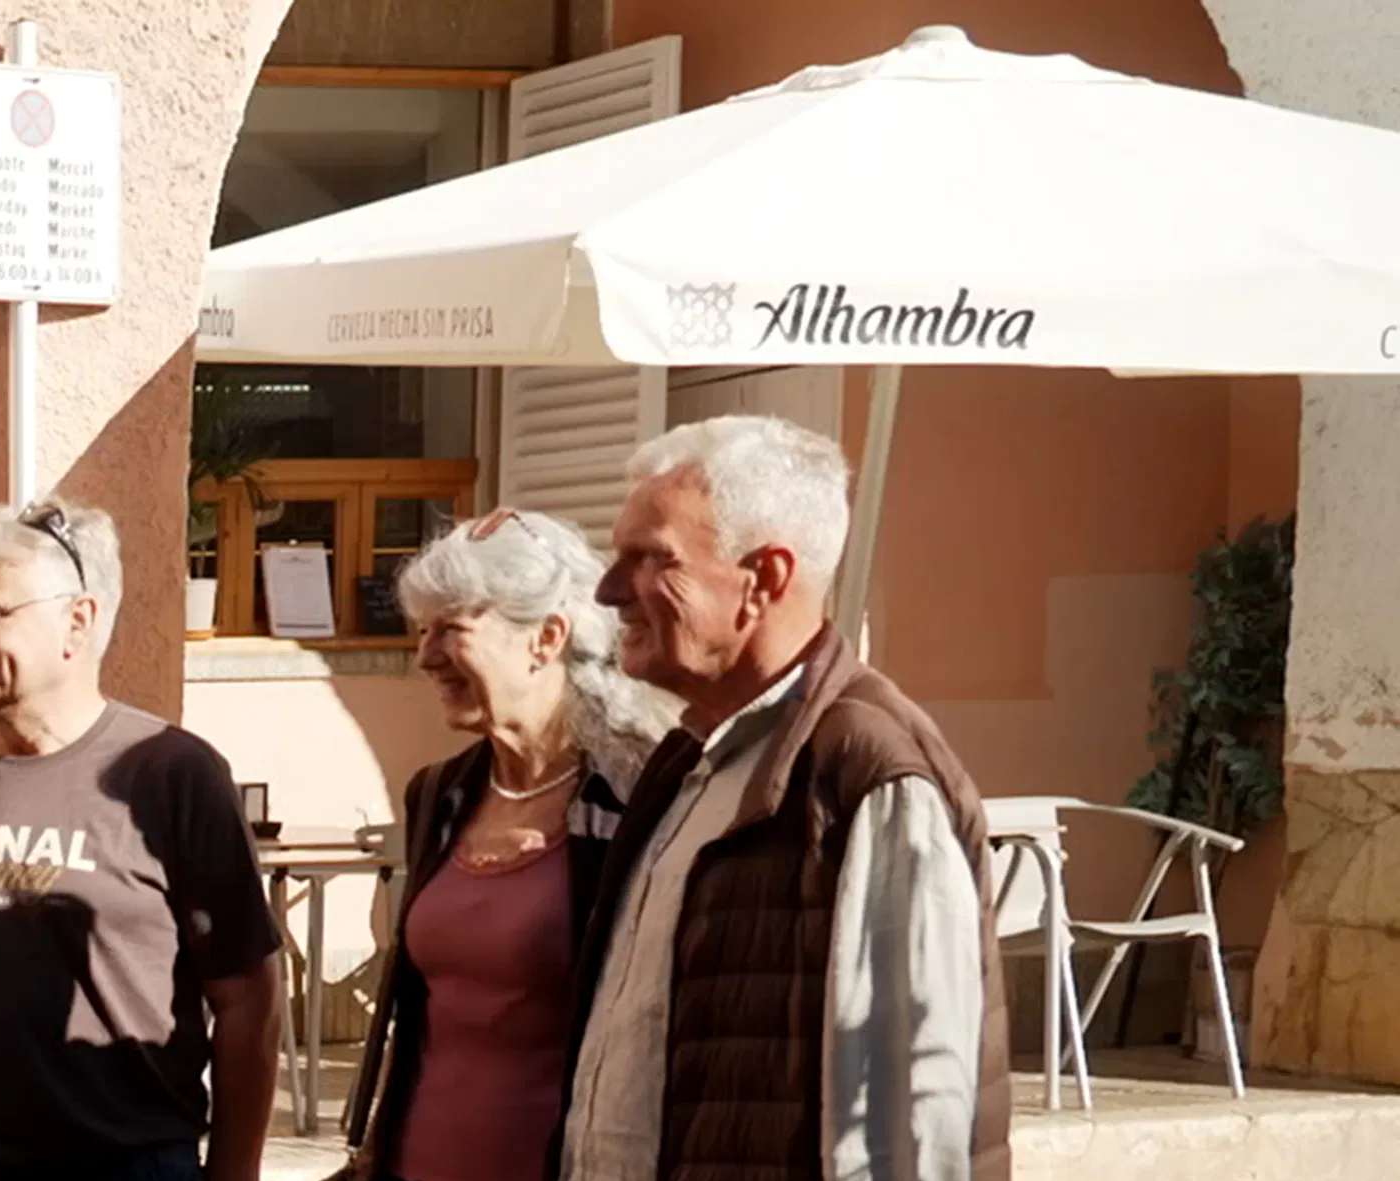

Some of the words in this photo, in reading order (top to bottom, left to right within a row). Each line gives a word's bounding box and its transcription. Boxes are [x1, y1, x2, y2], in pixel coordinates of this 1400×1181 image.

[327, 312, 375, 342] CERVEZA
[450, 304, 493, 338] PRISA
[751, 282, 1035, 351] Alhambra
